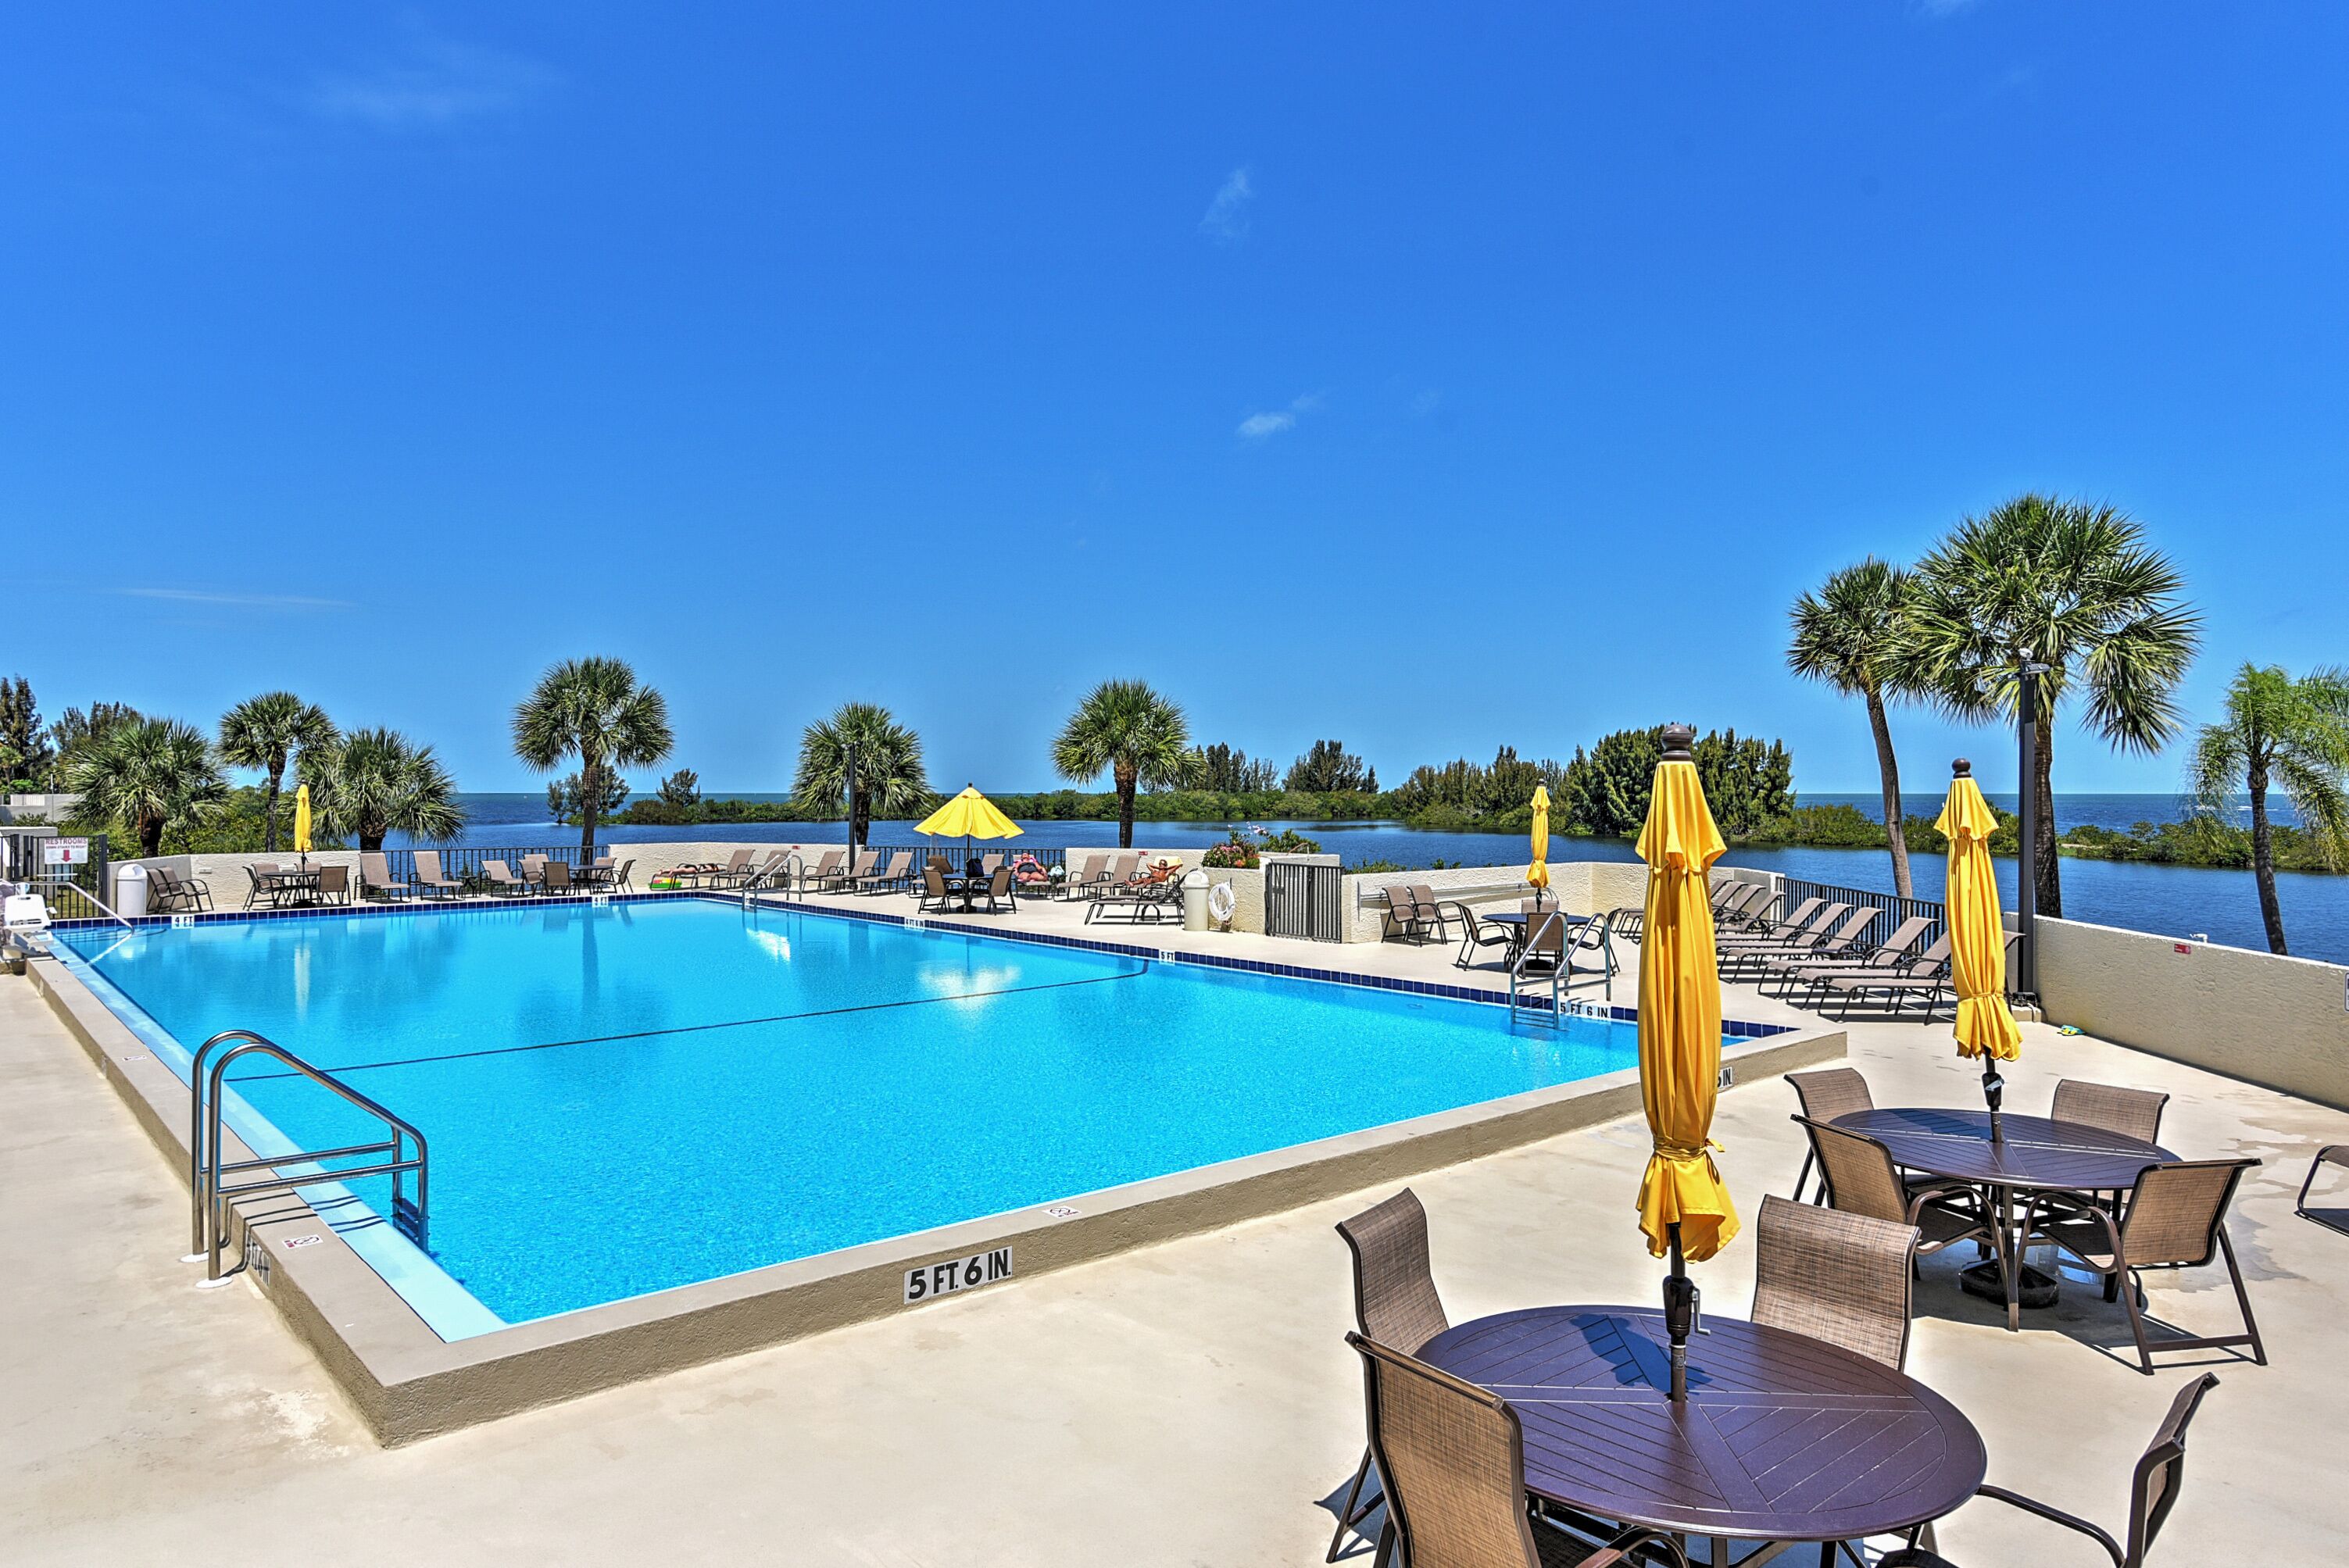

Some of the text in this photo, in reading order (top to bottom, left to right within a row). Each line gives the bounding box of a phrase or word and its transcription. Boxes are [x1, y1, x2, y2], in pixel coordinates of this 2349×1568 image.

[1161, 951, 1174, 961] 5 FT
[1561, 1002, 1566, 1013] 5
[1570, 1003, 1582, 1015] FT
[1586, 1005, 1593, 1016] 6
[908, 1248, 1011, 1299] 5 FT. 6 IN.
